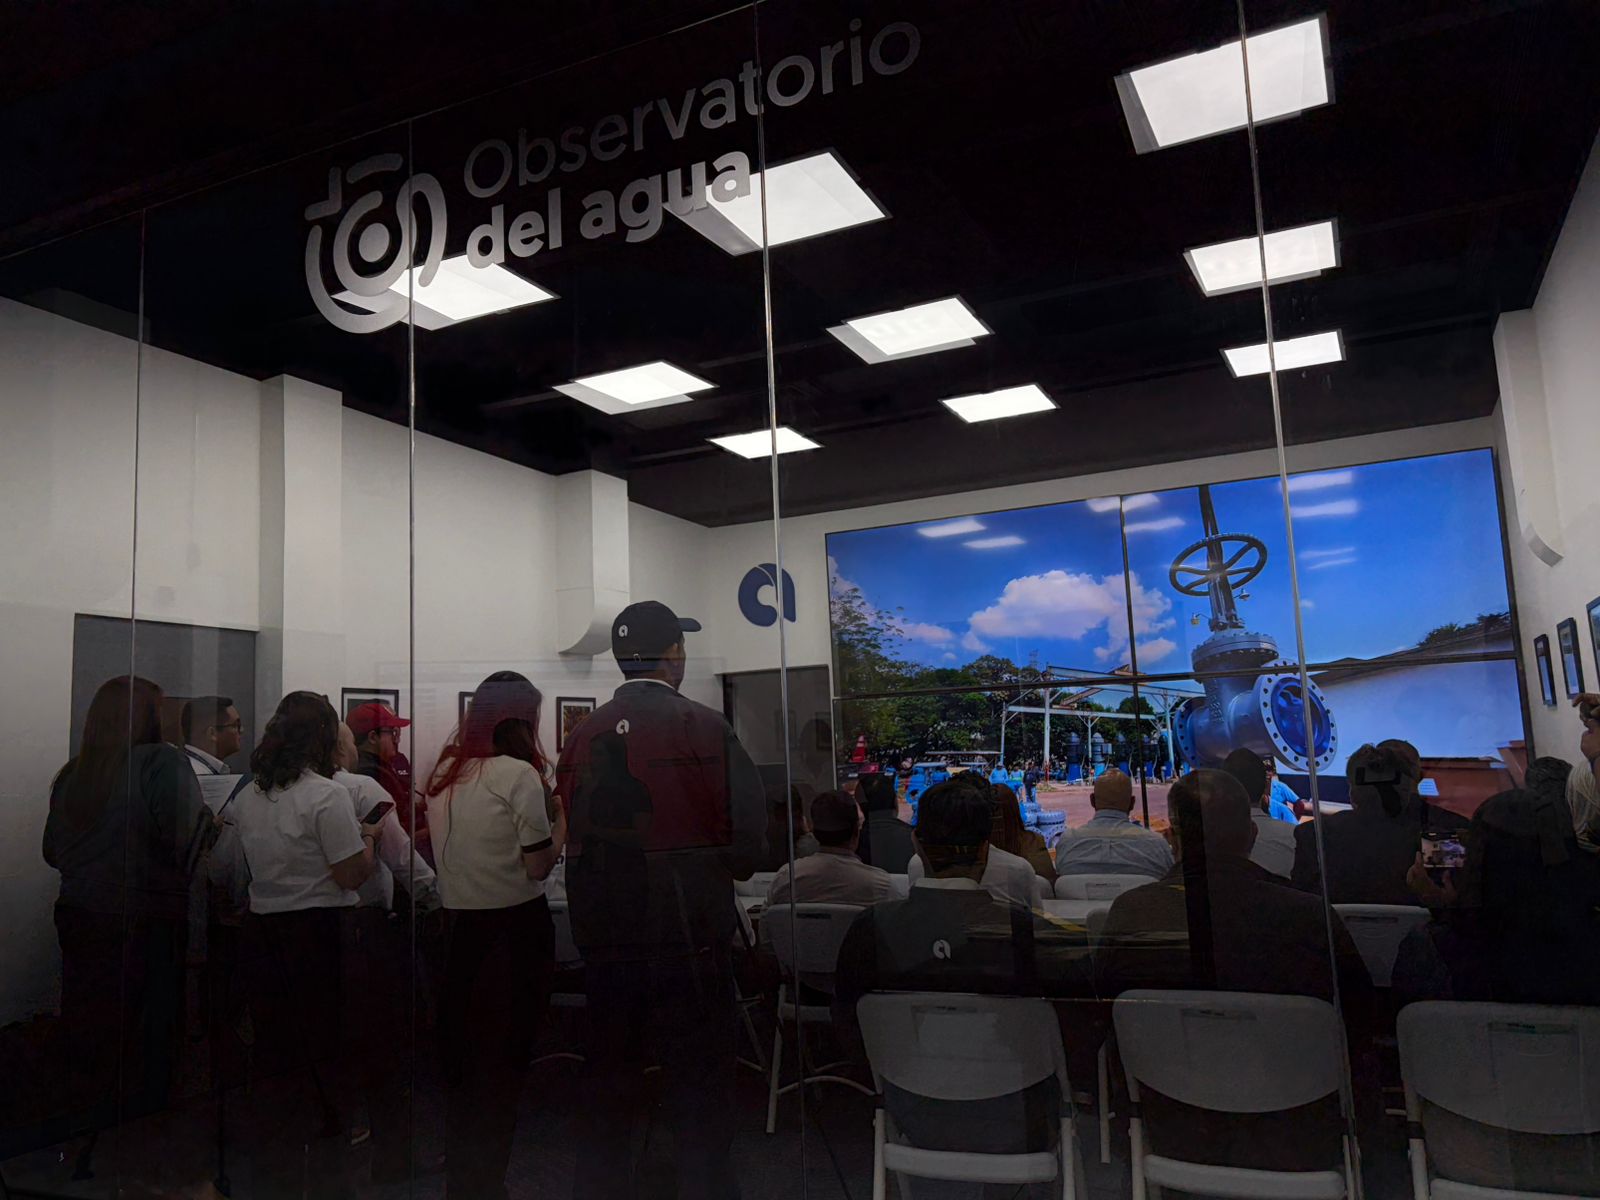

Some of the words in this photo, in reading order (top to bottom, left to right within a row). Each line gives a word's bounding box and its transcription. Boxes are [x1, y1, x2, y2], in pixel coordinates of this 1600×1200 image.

[464, 18, 922, 198] Observatorio
[466, 186, 564, 269] del
[580, 151, 751, 243] agua
